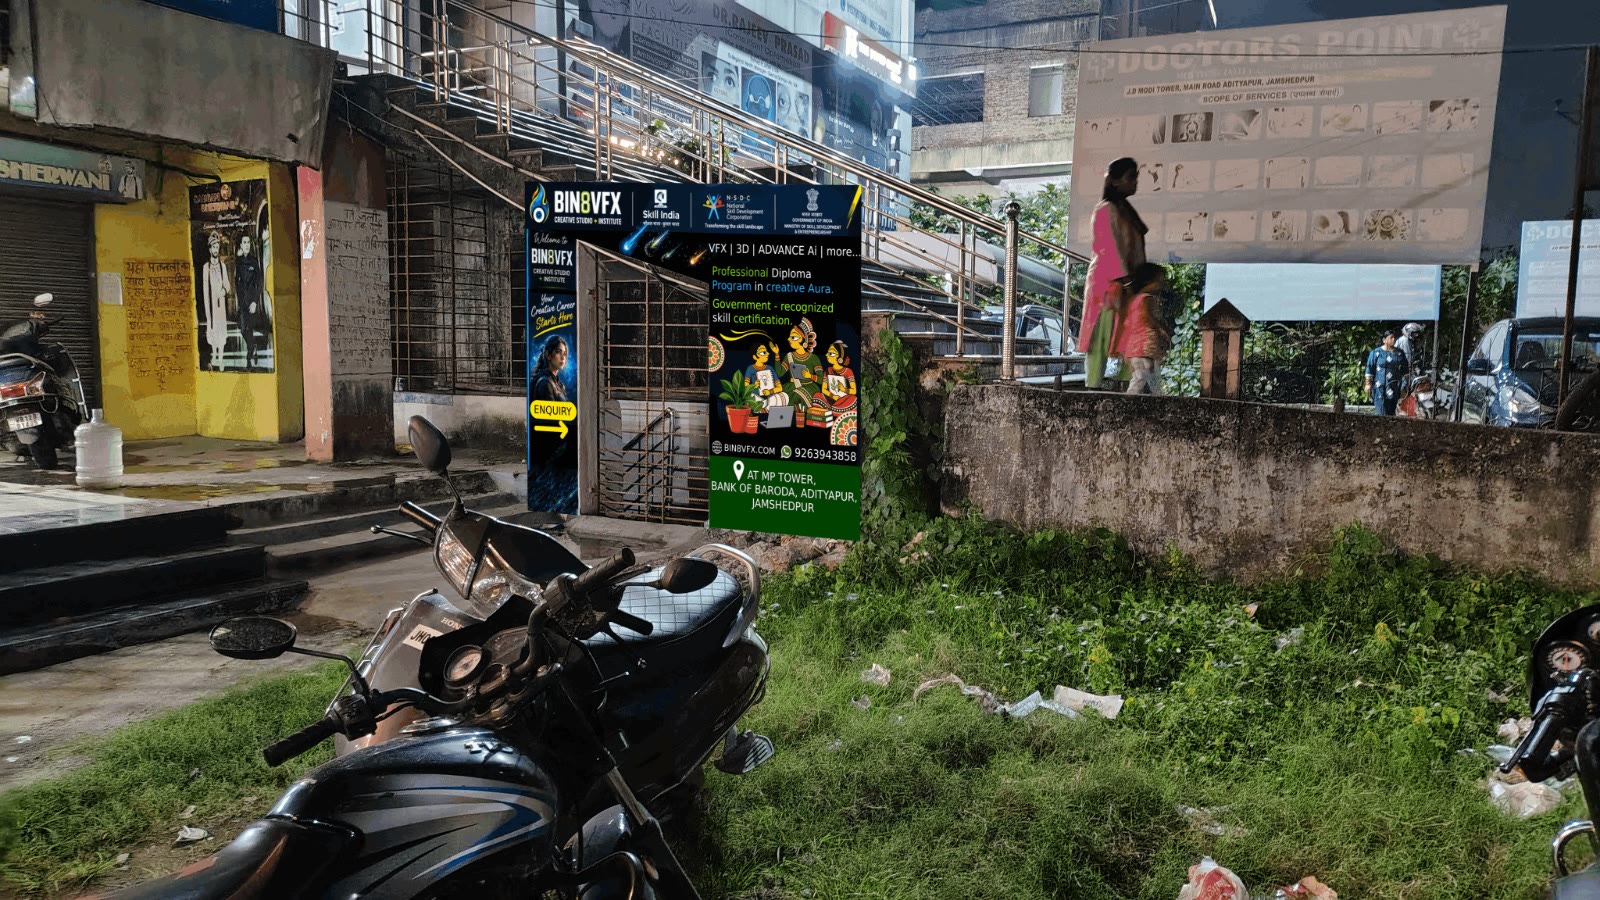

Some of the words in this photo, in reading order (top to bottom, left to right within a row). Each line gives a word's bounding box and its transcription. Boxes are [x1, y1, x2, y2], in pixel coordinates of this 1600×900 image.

[774, 35, 810, 64] PRASAD
[1118, 33, 1300, 74] DOCTORS
[1317, 22, 1452, 57] POINT
[1138, 86, 1155, 94] MODI
[1157, 84, 1182, 93] TOWER,
[1183, 83, 1200, 91] MAIN
[1202, 81, 1221, 89] ROAD
[1265, 76, 1315, 86] JAMSHEDPUR
[1203, 95, 1230, 103] SCOPE
[1232, 93, 1242, 101] OF
[0, 160, 110, 191] SHERWANI
[554, 190, 621, 215] BIN8VFX
[554, 216, 575, 224] CREATIVE
[598, 218, 622, 226] INSTITUTE
[643, 210, 659, 219] Skill
[660, 210, 680, 220] India
[534, 232, 560, 244] Welcome
[561, 235, 568, 245] to
[531, 248, 573, 267] BIN8VFX
[708, 243, 727, 253] VFX
[736, 244, 749, 254] 3D
[758, 244, 805, 256] ADVANCE
[807, 245, 817, 256] Ai
[826, 247, 861, 257] more...
[712, 266, 769, 278] Professional
[771, 268, 812, 280] Diploma
[712, 280, 752, 293] Program
[754, 281, 763, 292] in
[766, 282, 805, 293] creative
[807, 283, 834, 294] Aura.
[541, 294, 554, 306] Your
[712, 299, 771, 311] Government
[780, 302, 834, 314] recognized
[530, 305, 555, 317] Creative
[556, 301, 575, 312] Career
[536, 314, 557, 330] Starts
[558, 311, 574, 323] Here
[712, 313, 731, 323] skill
[733, 314, 793, 326] certification.
[534, 404, 572, 416] ENQUIRY
[724, 443, 776, 455] BIN8VFX.COM
[795, 447, 857, 462] 9263943858
[747, 470, 760, 480] AT
[761, 471, 776, 482] MP
[778, 472, 817, 486] TOWER,
[711, 481, 737, 493] BANK
[739, 483, 752, 493] OF
[754, 484, 798, 498] BARODA,
[800, 489, 858, 503] ADITYAPUR,
[751, 498, 815, 513] JAMSHEDPUR
[441, 617, 465, 630] HON
